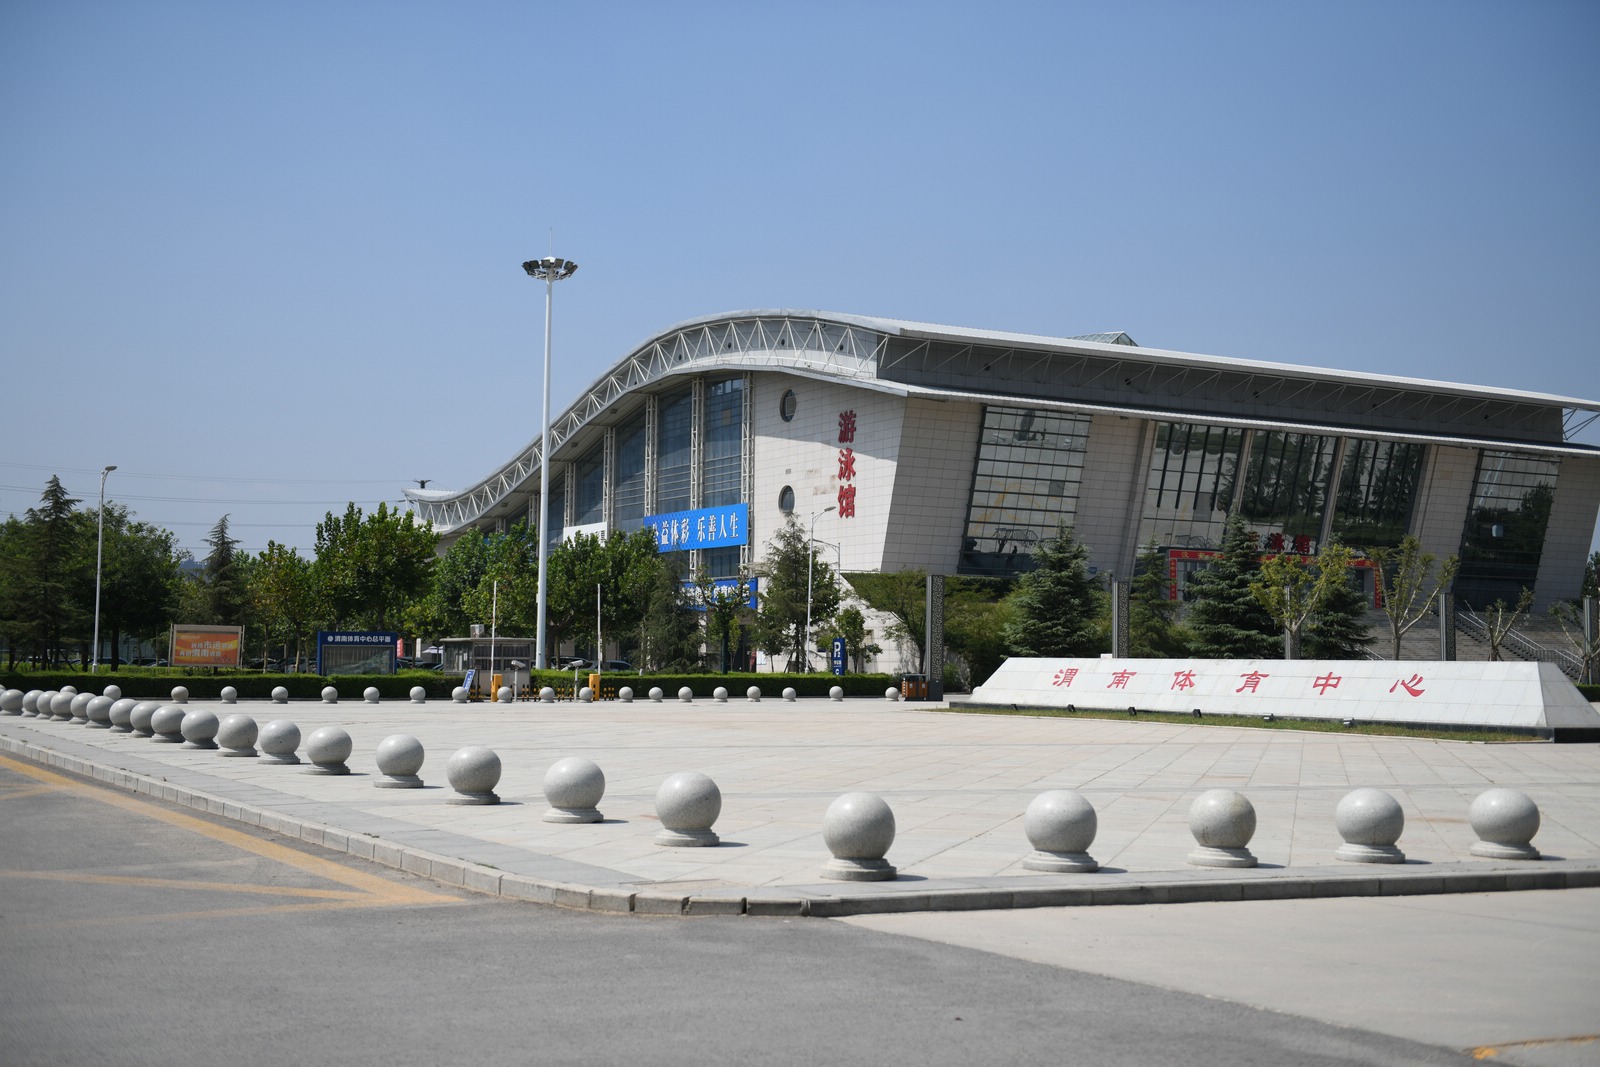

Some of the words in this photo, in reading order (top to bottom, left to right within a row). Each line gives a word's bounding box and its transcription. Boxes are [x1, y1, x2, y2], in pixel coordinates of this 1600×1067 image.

[837, 409, 857, 519] 游泳馆
[696, 511, 739, 543] 乐善人生
[1052, 667, 1426, 698] 渭南体育中心
